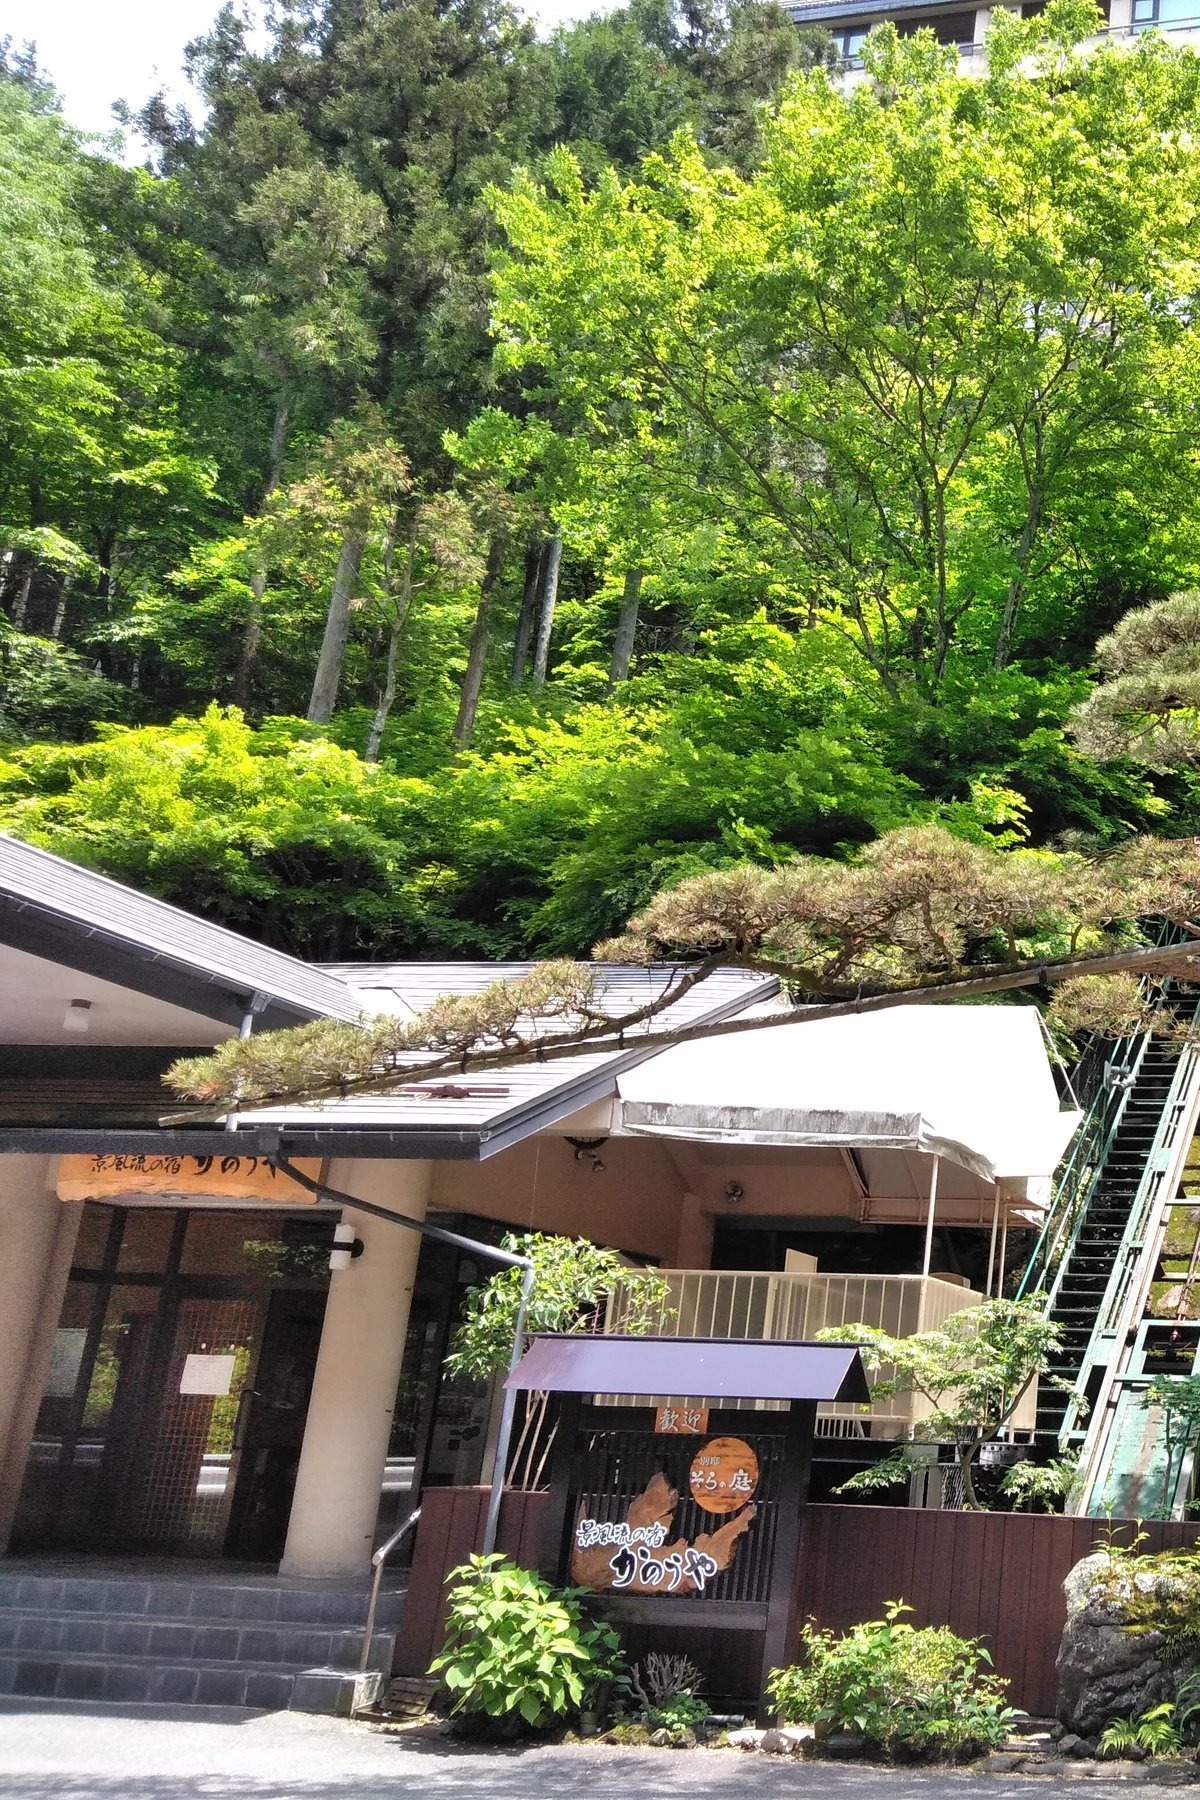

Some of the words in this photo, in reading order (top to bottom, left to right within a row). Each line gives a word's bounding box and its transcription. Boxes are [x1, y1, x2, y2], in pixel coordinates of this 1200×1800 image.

[659, 1408, 702, 1433] 歓迎
[690, 1469, 753, 1491] そらの庭
[576, 1520, 668, 1548] 景風流の宿
[610, 1547, 717, 1591] かのうや
